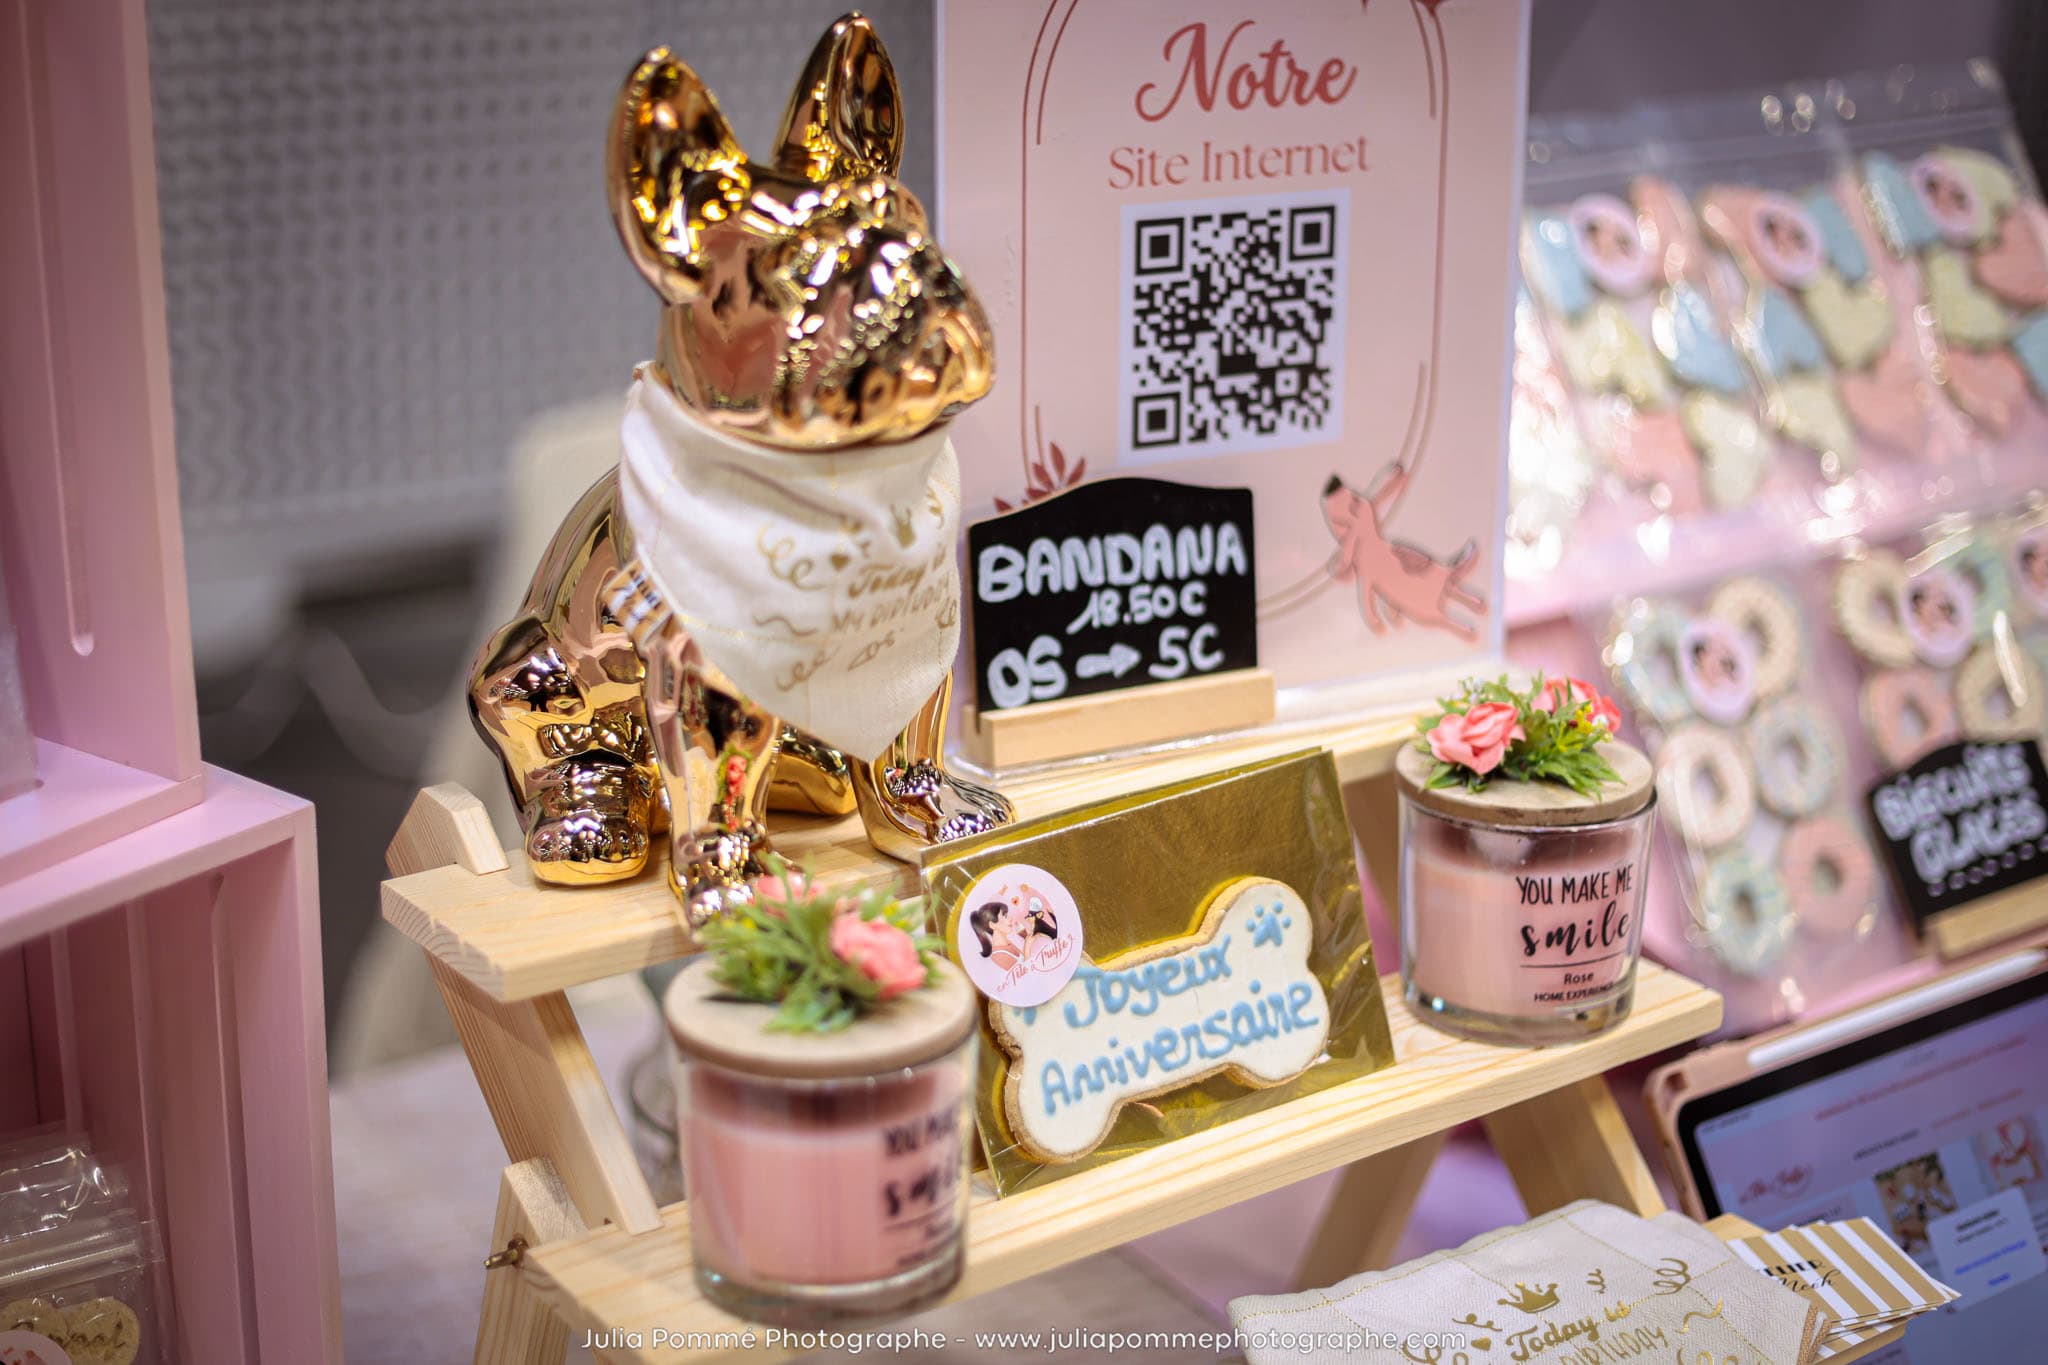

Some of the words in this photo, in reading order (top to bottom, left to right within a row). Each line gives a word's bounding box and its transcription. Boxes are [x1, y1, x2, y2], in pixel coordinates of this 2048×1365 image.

[1135, 20, 1358, 122] Notre
[1108, 147, 1190, 190] Site
[1203, 136, 1371, 183] Internet
[978, 522, 1247, 603] BANDANA
[987, 634, 1068, 709] OS
[1515, 876, 1553, 905] YOU
[1561, 871, 1610, 904] MAKE
[1615, 863, 1634, 895] ME
[1520, 899, 1631, 957] smile
[1064, 933, 1232, 1029] Joyeux
[1533, 991, 1564, 1002] HOME
[1563, 972, 1594, 985] Rose
[1040, 979, 1320, 1117] Anniversaire
[1505, 1305, 1601, 1362] Today
